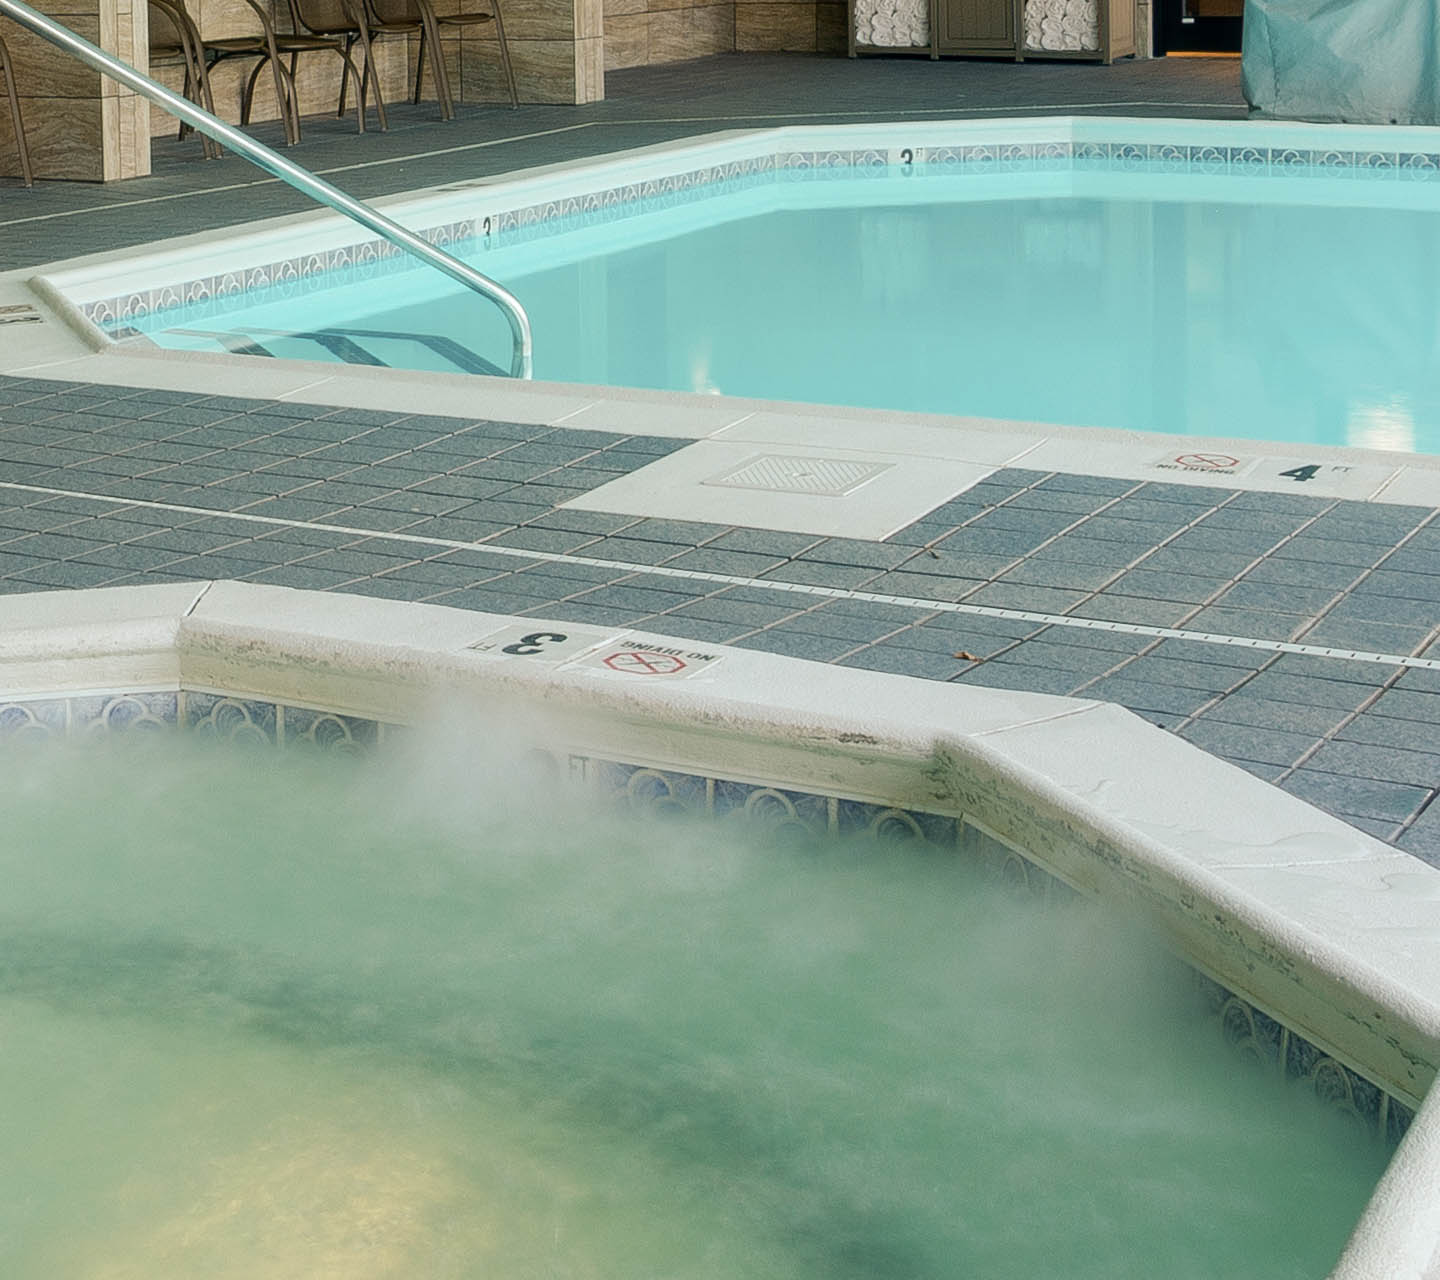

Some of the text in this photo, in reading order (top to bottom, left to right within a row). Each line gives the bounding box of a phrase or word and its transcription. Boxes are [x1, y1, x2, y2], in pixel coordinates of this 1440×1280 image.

[1278, 464, 1323, 482] 4
[502, 632, 568, 655] 3
[620, 640, 716, 662] NO DIVING
